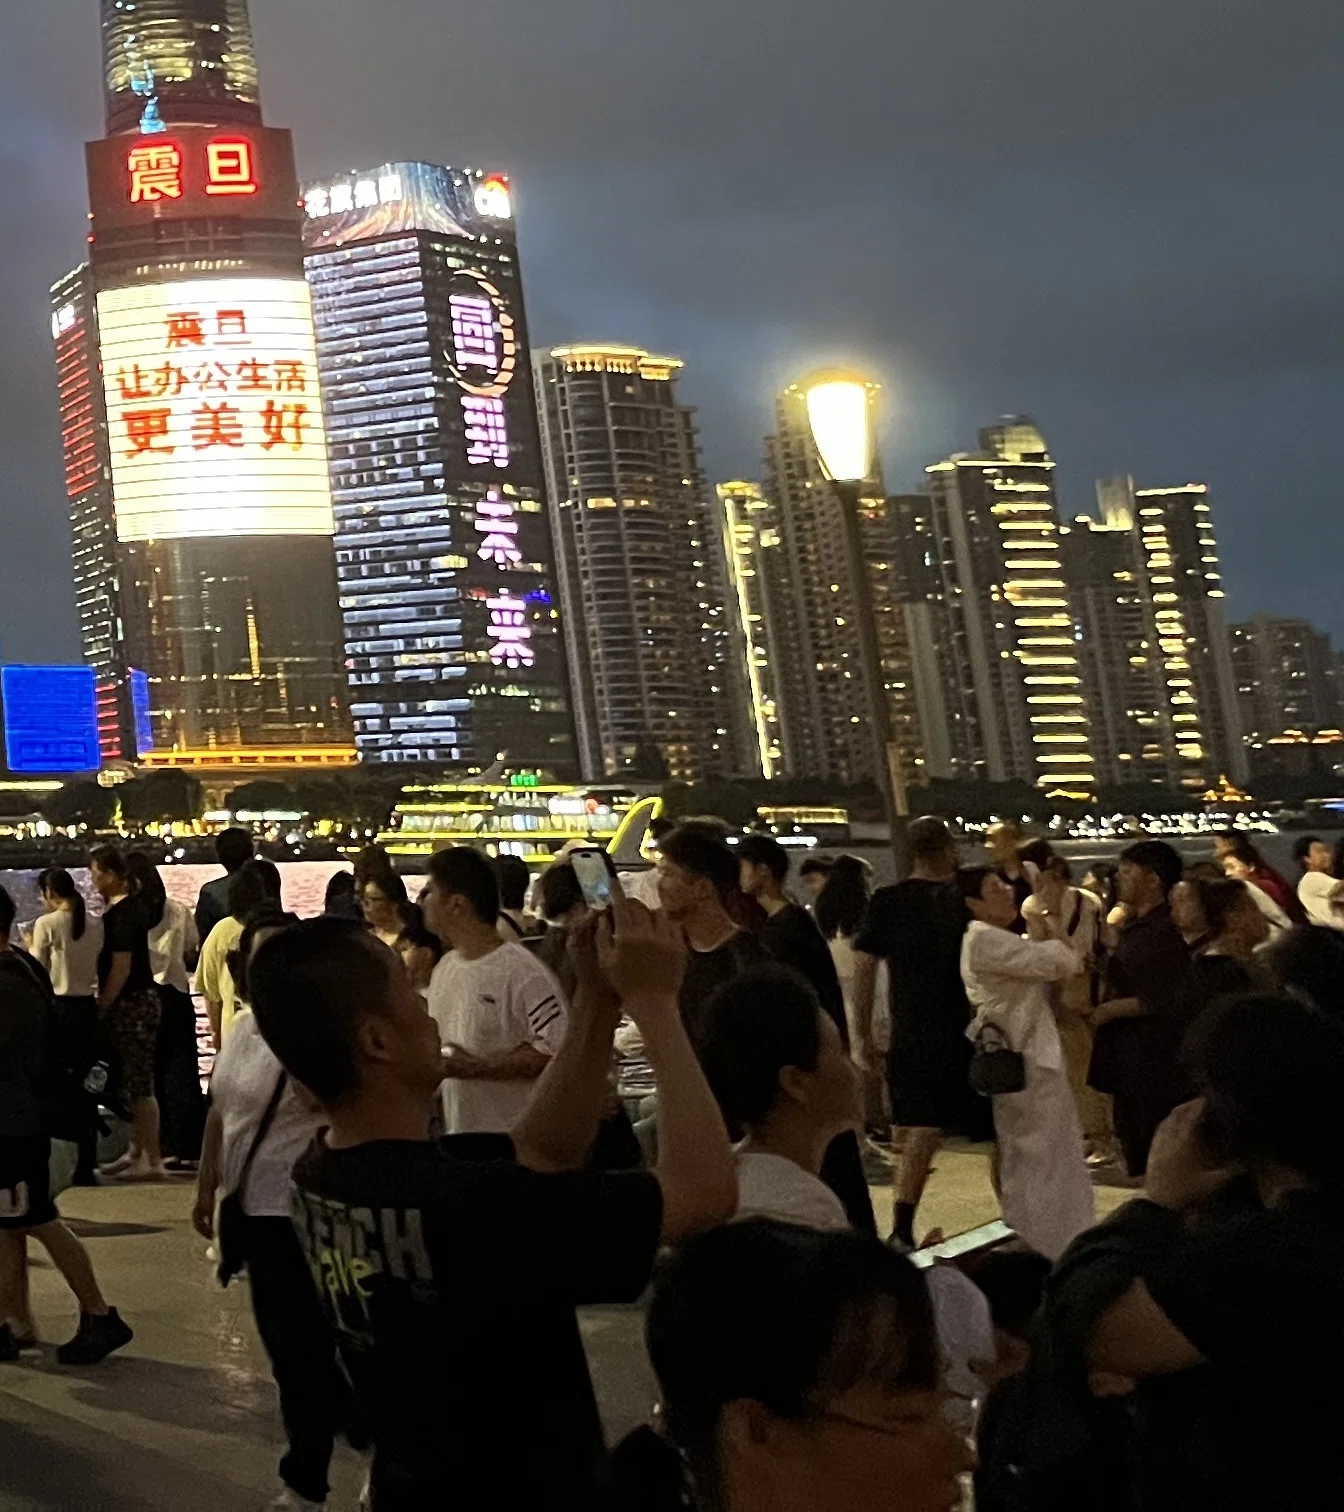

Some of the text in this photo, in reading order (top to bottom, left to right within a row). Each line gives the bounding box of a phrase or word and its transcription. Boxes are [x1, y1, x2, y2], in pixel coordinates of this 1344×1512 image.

[128, 142, 257, 203] 震旦
[164, 309, 253, 348] 震旦
[115, 357, 306, 401] 让办公生活
[121, 400, 311, 459] 更美好
